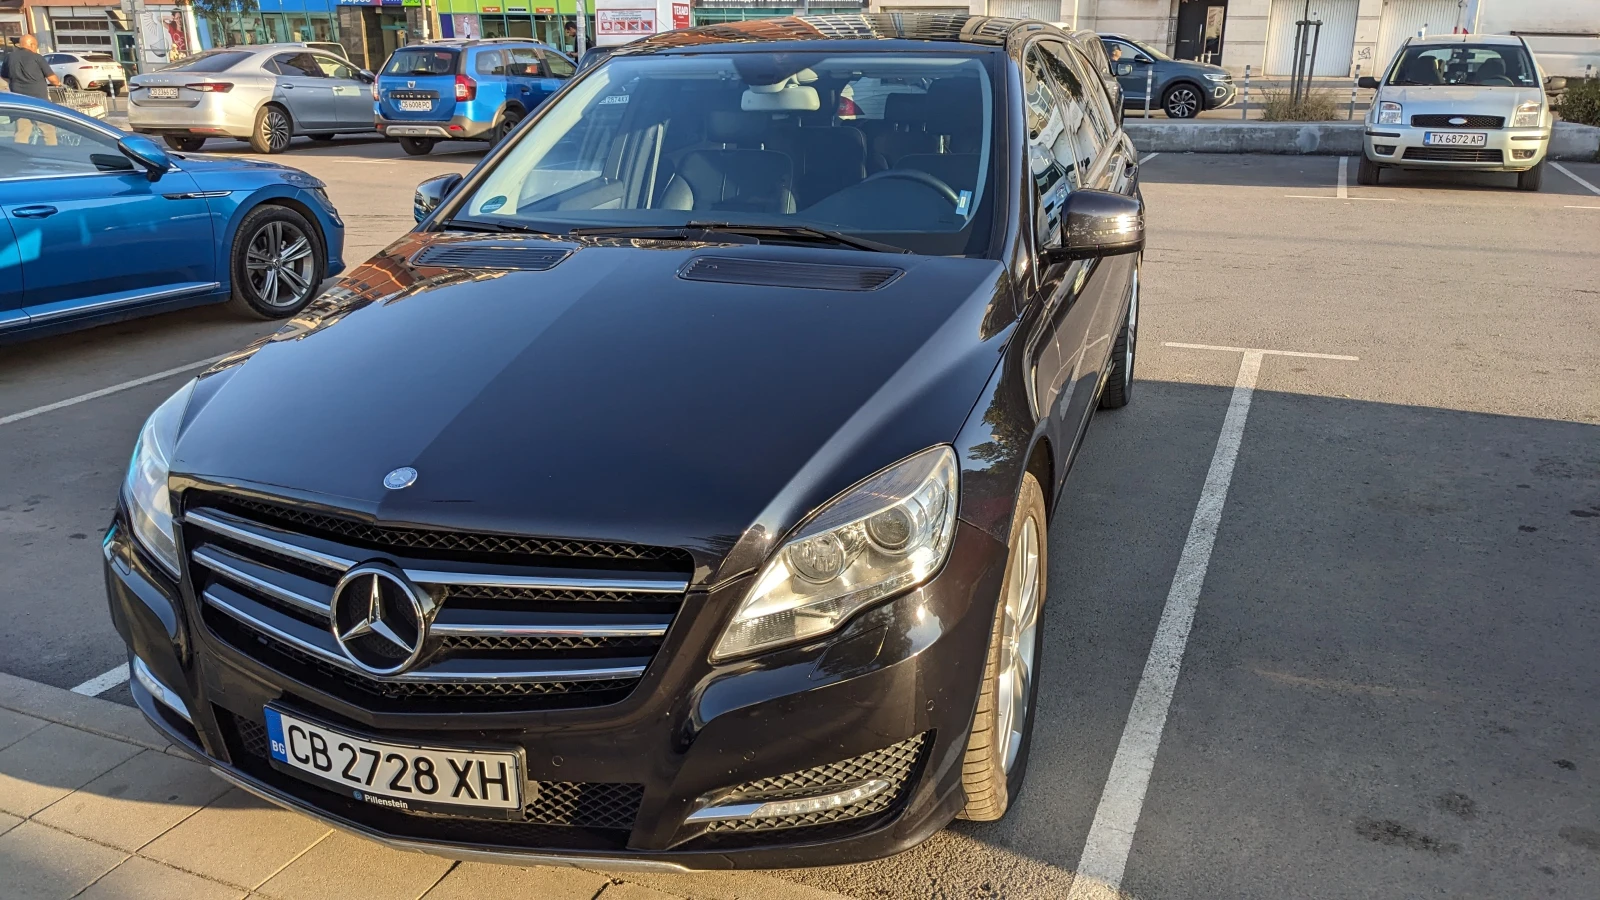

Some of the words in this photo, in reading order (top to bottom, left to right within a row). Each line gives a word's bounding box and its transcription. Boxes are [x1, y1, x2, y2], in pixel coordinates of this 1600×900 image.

[1431, 134, 1444, 144] TX
[1445, 134, 1469, 144] 6872
[1470, 135, 1484, 145] AP
[271, 739, 286, 755] BG
[288, 724, 333, 773] CB
[338, 742, 441, 796] 2728
[448, 757, 512, 802] XH
[364, 793, 409, 809] Pillenstein
